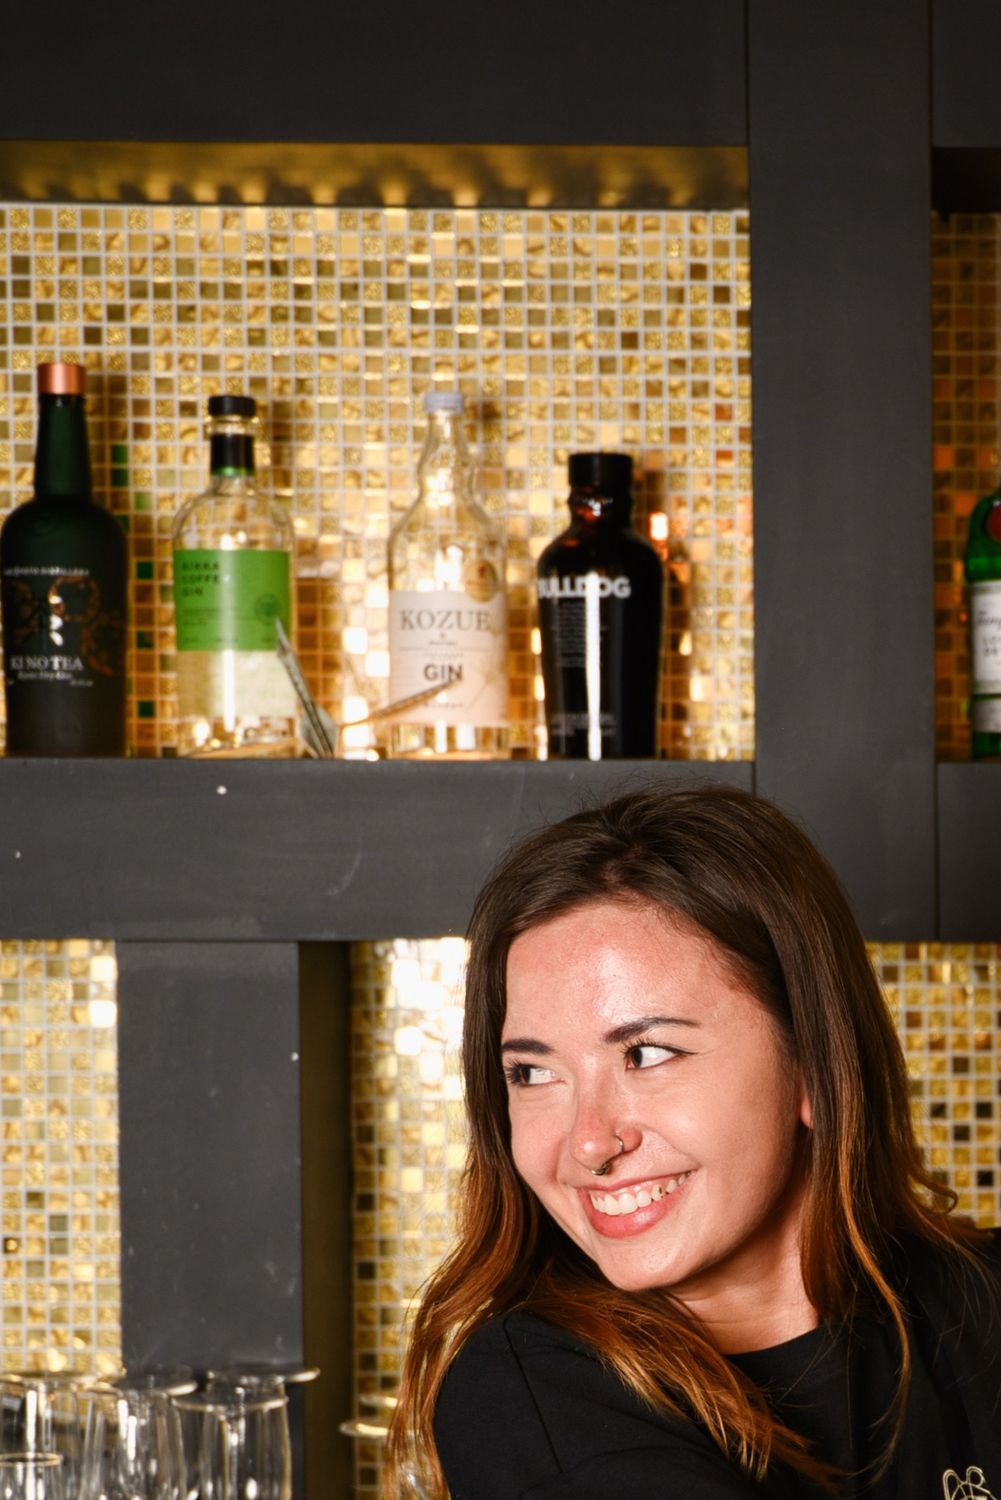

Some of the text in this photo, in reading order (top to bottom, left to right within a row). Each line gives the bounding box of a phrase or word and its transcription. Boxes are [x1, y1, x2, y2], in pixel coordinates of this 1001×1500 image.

[182, 573, 231, 583] COFFE
[538, 575, 632, 599] ULLDOG
[401, 609, 492, 631] KOZUE
[51, 656, 84, 671] TEA
[423, 663, 463, 682] GIN
